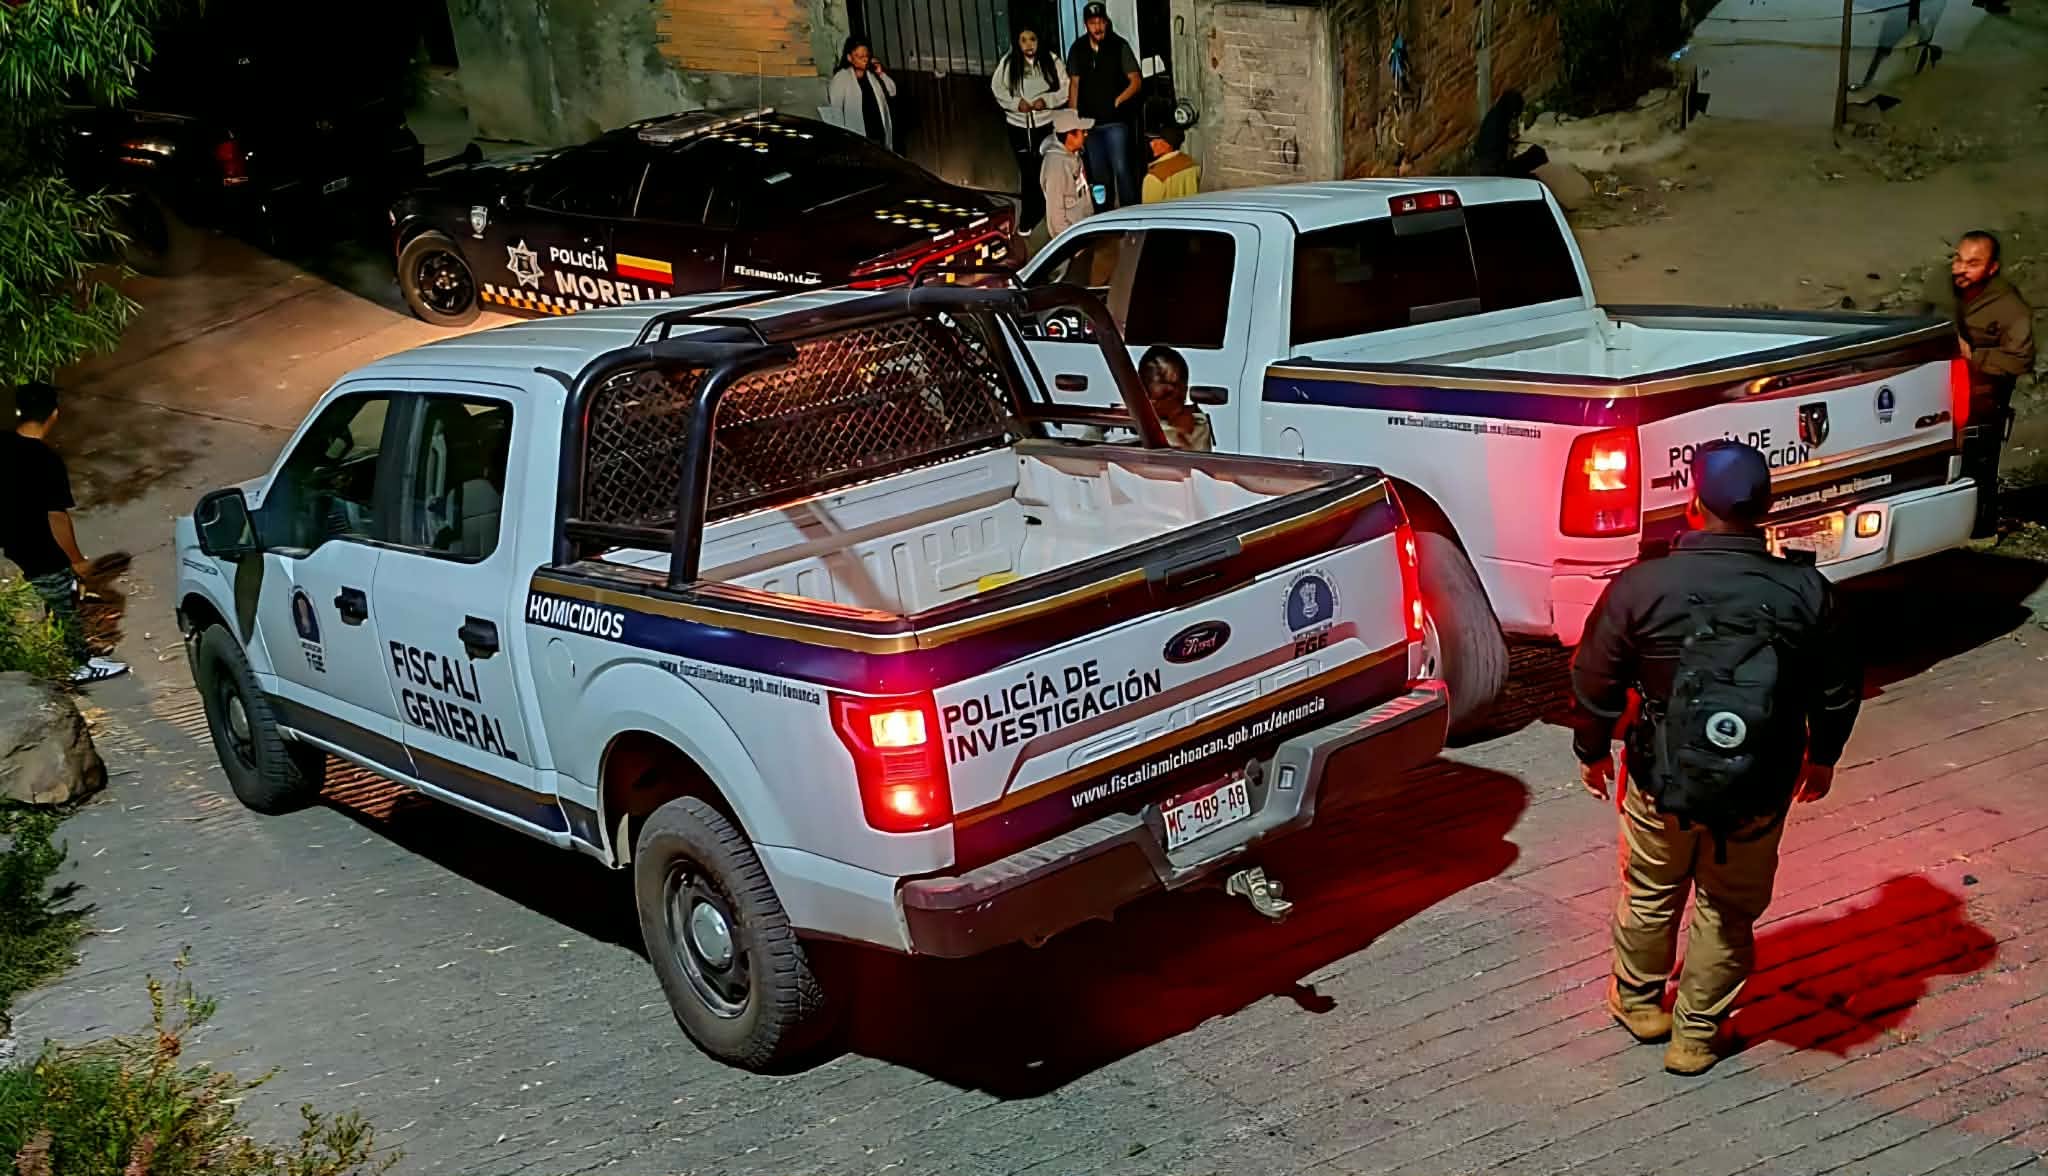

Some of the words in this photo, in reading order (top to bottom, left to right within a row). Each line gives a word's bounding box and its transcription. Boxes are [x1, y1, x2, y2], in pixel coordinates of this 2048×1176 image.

[549, 246, 608, 272] POLICÍA
[529, 594, 625, 638] HOMICIDIOS
[402, 688, 519, 761] GENERAL
[943, 671, 1058, 733] POLICÍA
[1063, 659, 1100, 694] DE
[949, 668, 1162, 765] INVESTIGACIÓN
[1071, 695, 1325, 808] www.fiscaliamichoacan.gob.mx/denuncia
